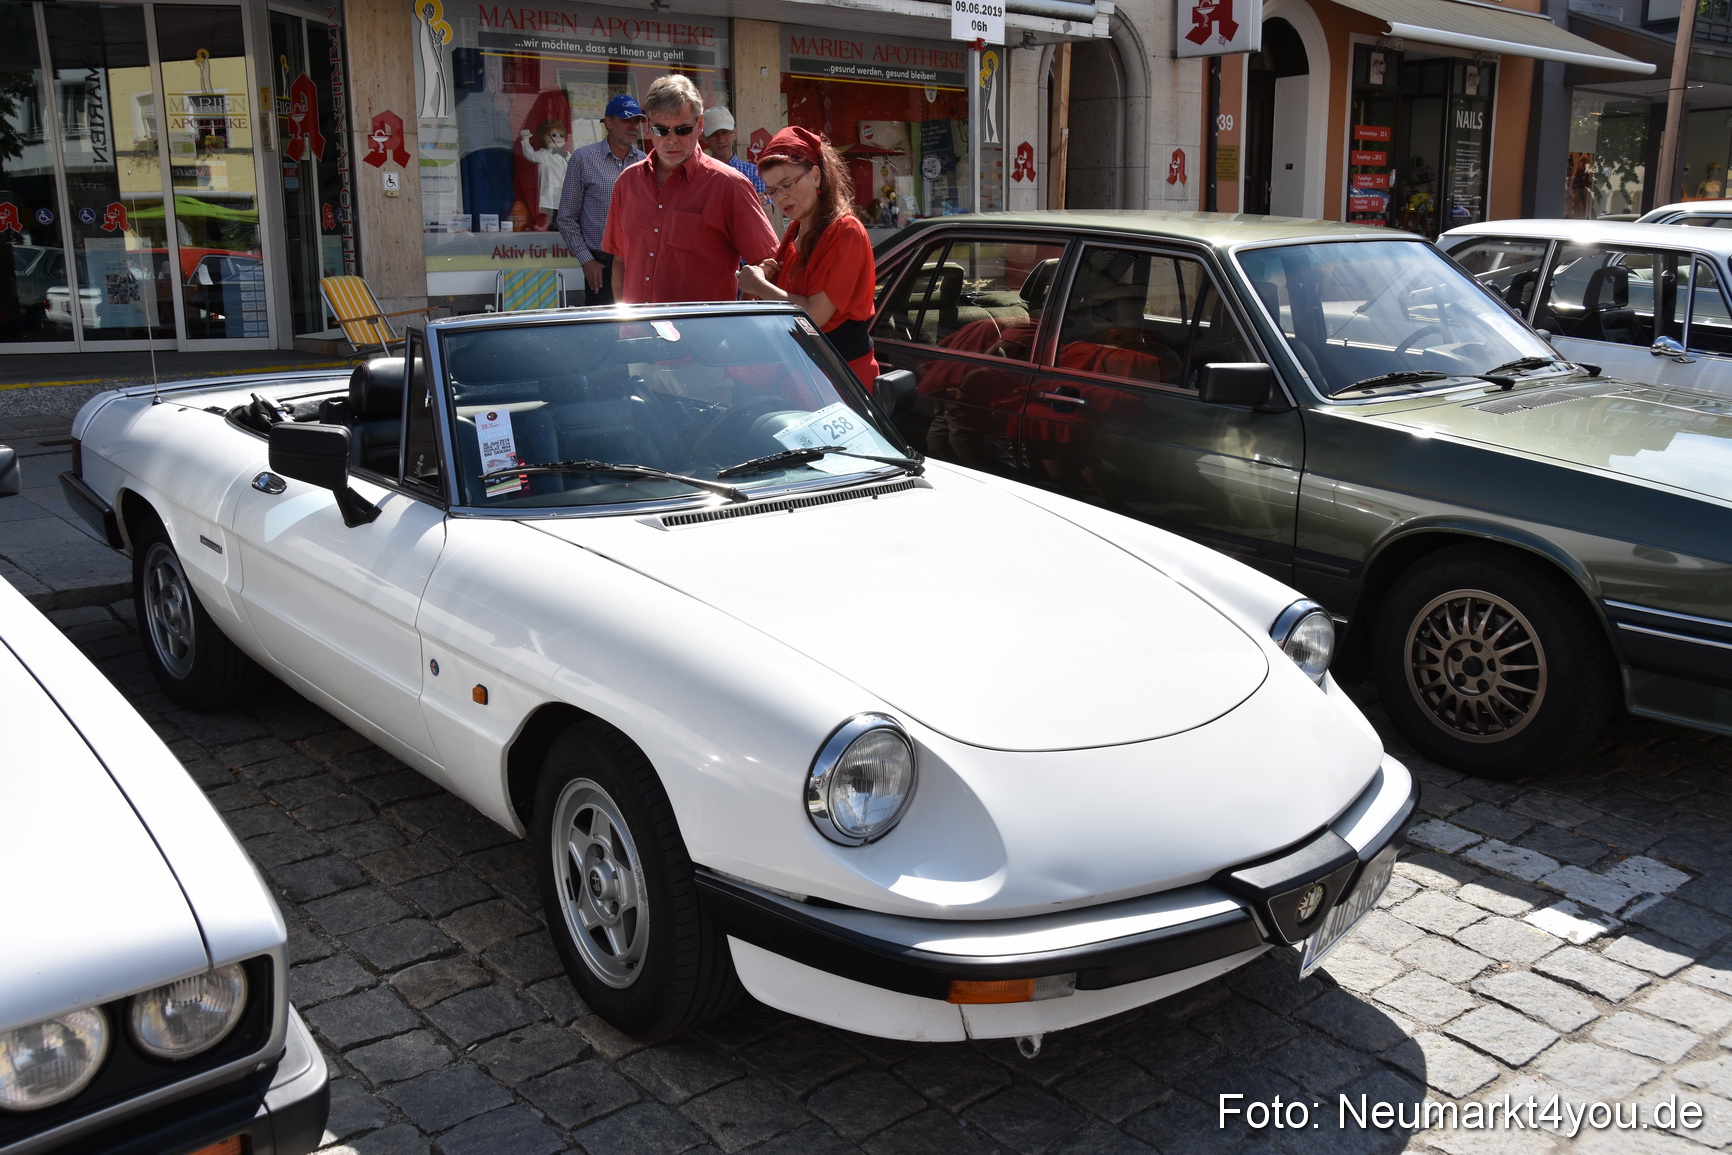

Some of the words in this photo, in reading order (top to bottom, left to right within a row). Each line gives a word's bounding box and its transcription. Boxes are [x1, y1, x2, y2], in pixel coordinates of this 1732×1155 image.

[955, 0, 1003, 17] 09.06.2019
[478, 4, 577, 34] MARIEN
[590, 15, 715, 47] APOTHEKE
[971, 19, 988, 32] 06h
[541, 39, 584, 54] möchten,
[585, 42, 606, 54] dass
[608, 46, 618, 54] es
[620, 45, 645, 57] Ihnen
[647, 49, 661, 60] gut
[662, 49, 684, 61] geht!
[790, 35, 863, 60] MARIEN
[872, 43, 966, 70] APOTHEKE
[857, 66, 885, 77] werden,
[885, 69, 910, 79] gesund
[910, 69, 937, 80] bleiben!
[169, 97, 246, 113] MARIEN
[170, 118, 248, 129] APOTHEKE
[1219, 114, 1234, 131] 39
[1456, 110, 1483, 130] NAILS
[326, 5, 346, 134] MARIEN
[336, 142, 359, 276] APOTHE
[492, 244, 526, 260] Aktiv
[529, 243, 549, 259] für
[823, 416, 854, 441] 258
